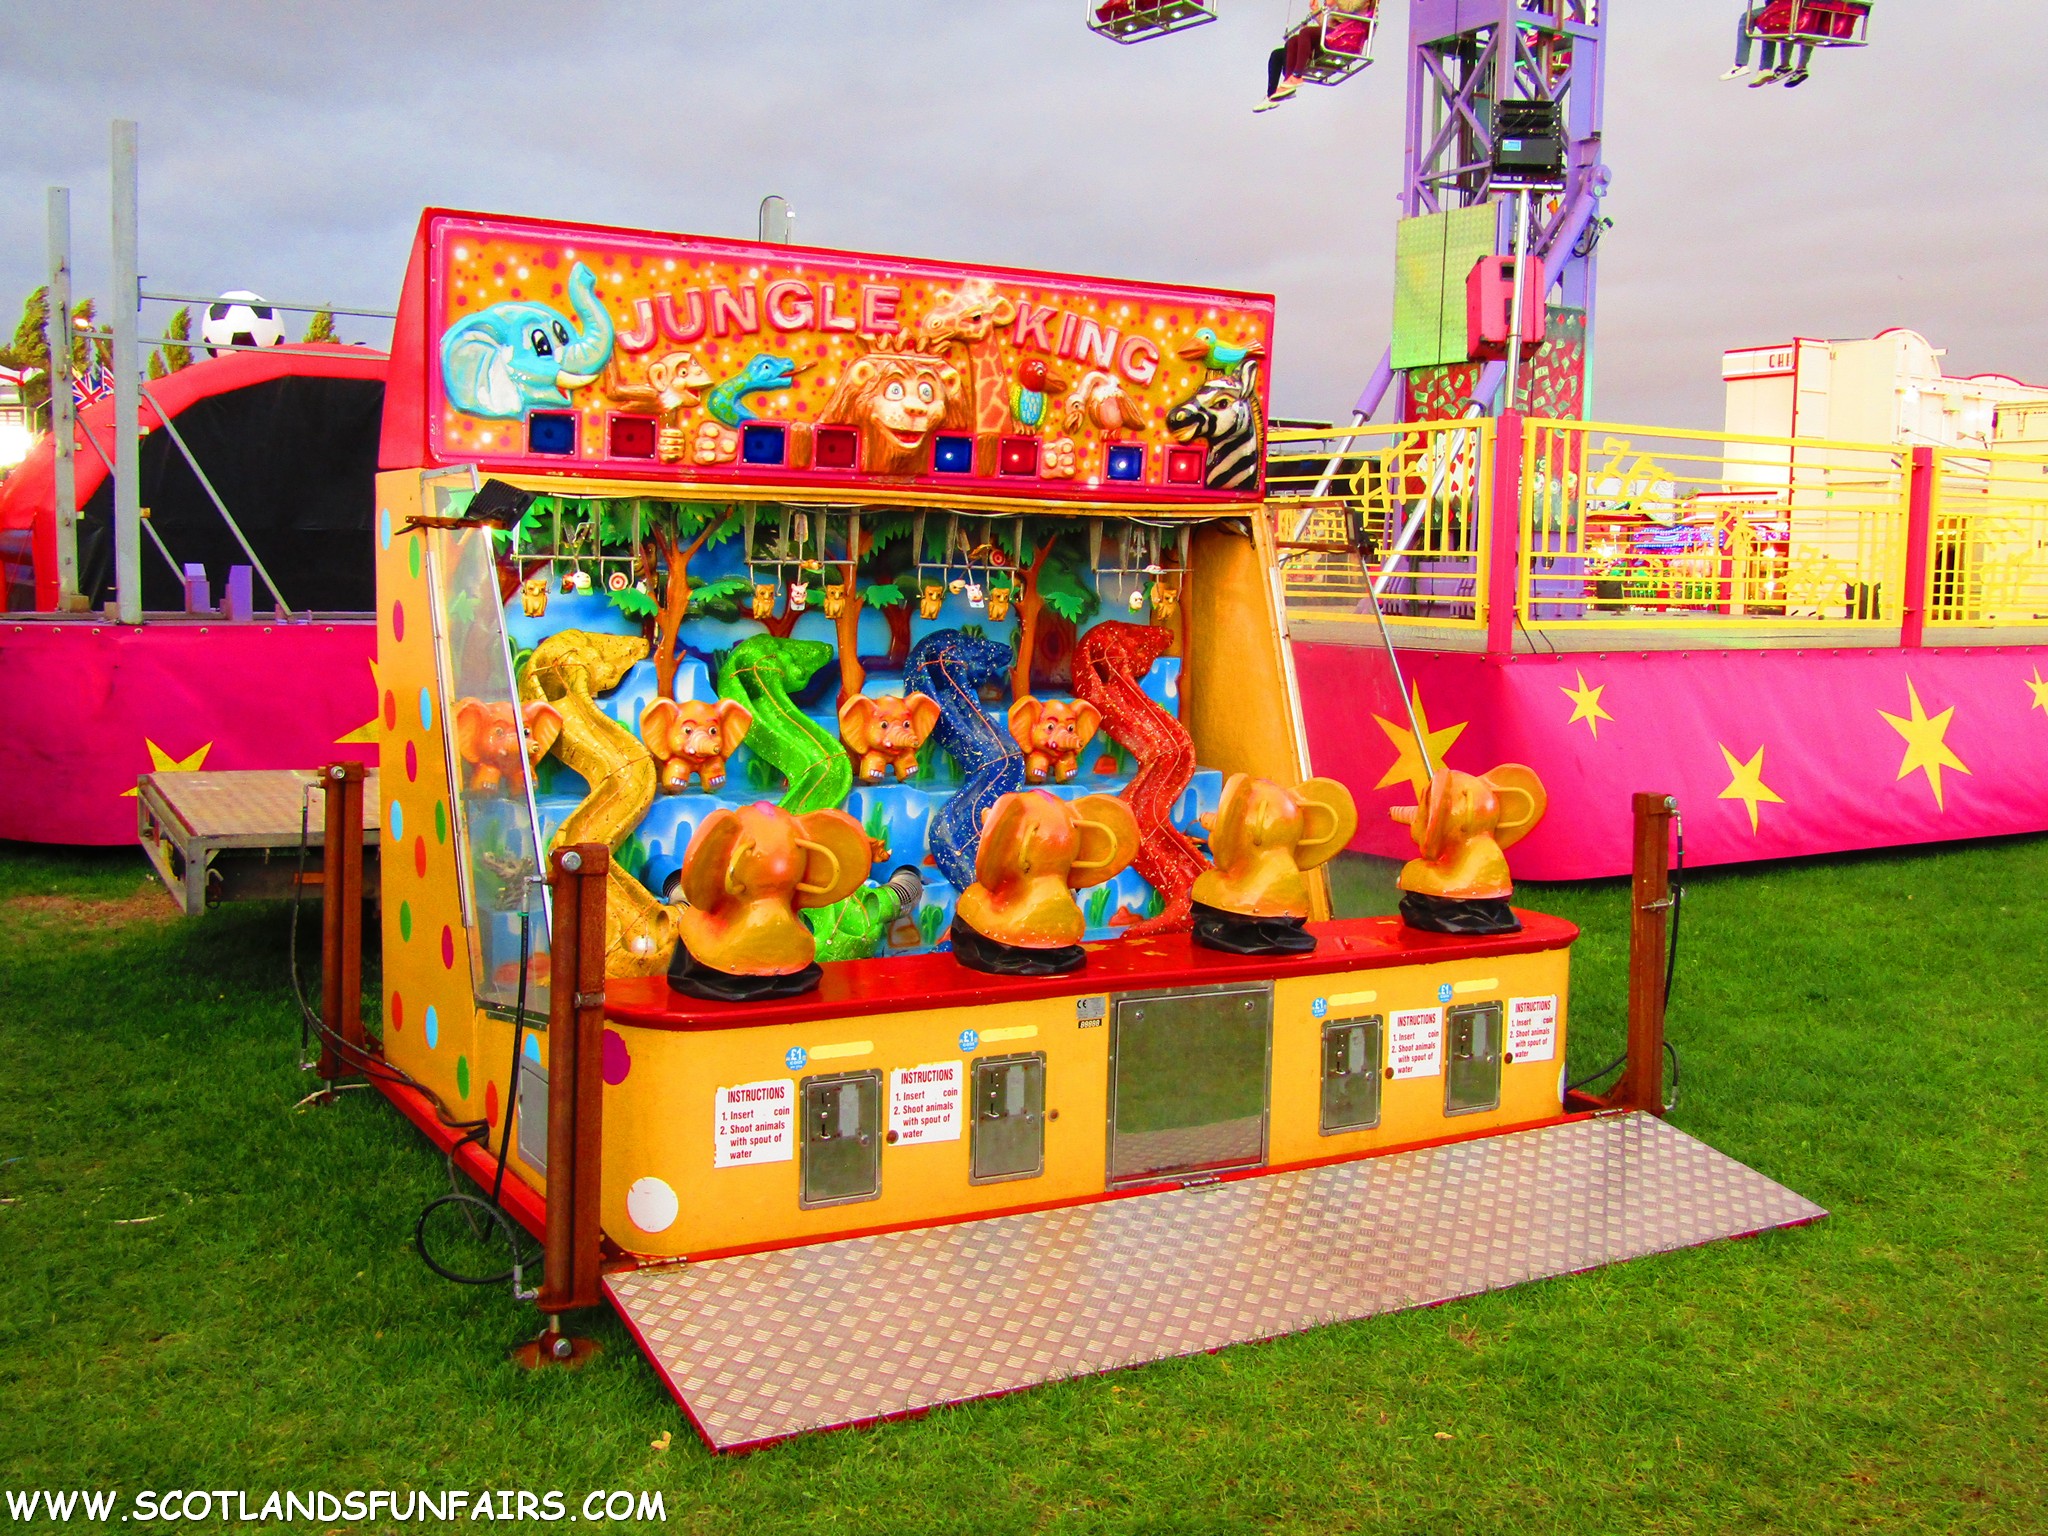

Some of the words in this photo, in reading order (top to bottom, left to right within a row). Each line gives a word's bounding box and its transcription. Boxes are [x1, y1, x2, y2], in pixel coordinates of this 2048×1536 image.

[616, 280, 900, 354] JUNGLE
[1011, 301, 1161, 386] KING
[1515, 1000, 1551, 1013] INSTRUCTIONS
[1397, 1013, 1436, 1027] INSTRUCTIONS
[1517, 1018, 1531, 1026] Insert
[1543, 1016, 1553, 1024] coin
[963, 1030, 974, 1043] £1
[1399, 1032, 1415, 1041] Insert
[1428, 1030, 1439, 1038] coin
[1516, 1029, 1530, 1038] Shoot
[1531, 1027, 1550, 1036] animals
[1398, 1044, 1414, 1052] Shoot
[1415, 1042, 1436, 1051] animals
[1516, 1040, 1526, 1048] with
[1528, 1038, 1541, 1047] spout
[790, 1047, 802, 1060] £1
[1398, 1055, 1410, 1063] with
[1411, 1053, 1426, 1063] spout
[1428, 1052, 1434, 1060] of
[1515, 1050, 1529, 1058] water
[901, 1068, 953, 1084] INSTRUCTIONS
[1397, 1066, 1413, 1074] water
[727, 1086, 785, 1103] INSTRUCTIONS
[896, 1092, 901, 1101] 1.
[904, 1090, 925, 1101] Insert
[943, 1087, 958, 1097] coin
[722, 1112, 728, 1120] 1.
[730, 1110, 754, 1120] Insert
[773, 1106, 790, 1116] coin
[893, 1106, 901, 1115] 2.
[903, 1104, 923, 1114] Shoot
[925, 1101, 954, 1112] animals
[903, 1117, 919, 1126] with
[921, 1115, 941, 1126] spout
[943, 1113, 950, 1122] of
[720, 1126, 727, 1135] 2.
[730, 1124, 752, 1134] Shoot
[755, 1120, 785, 1132] animals
[903, 1129, 923, 1139] water
[730, 1137, 747, 1147] with
[750, 1135, 771, 1147] spout
[774, 1133, 782, 1142] of
[730, 1150, 752, 1160] water
